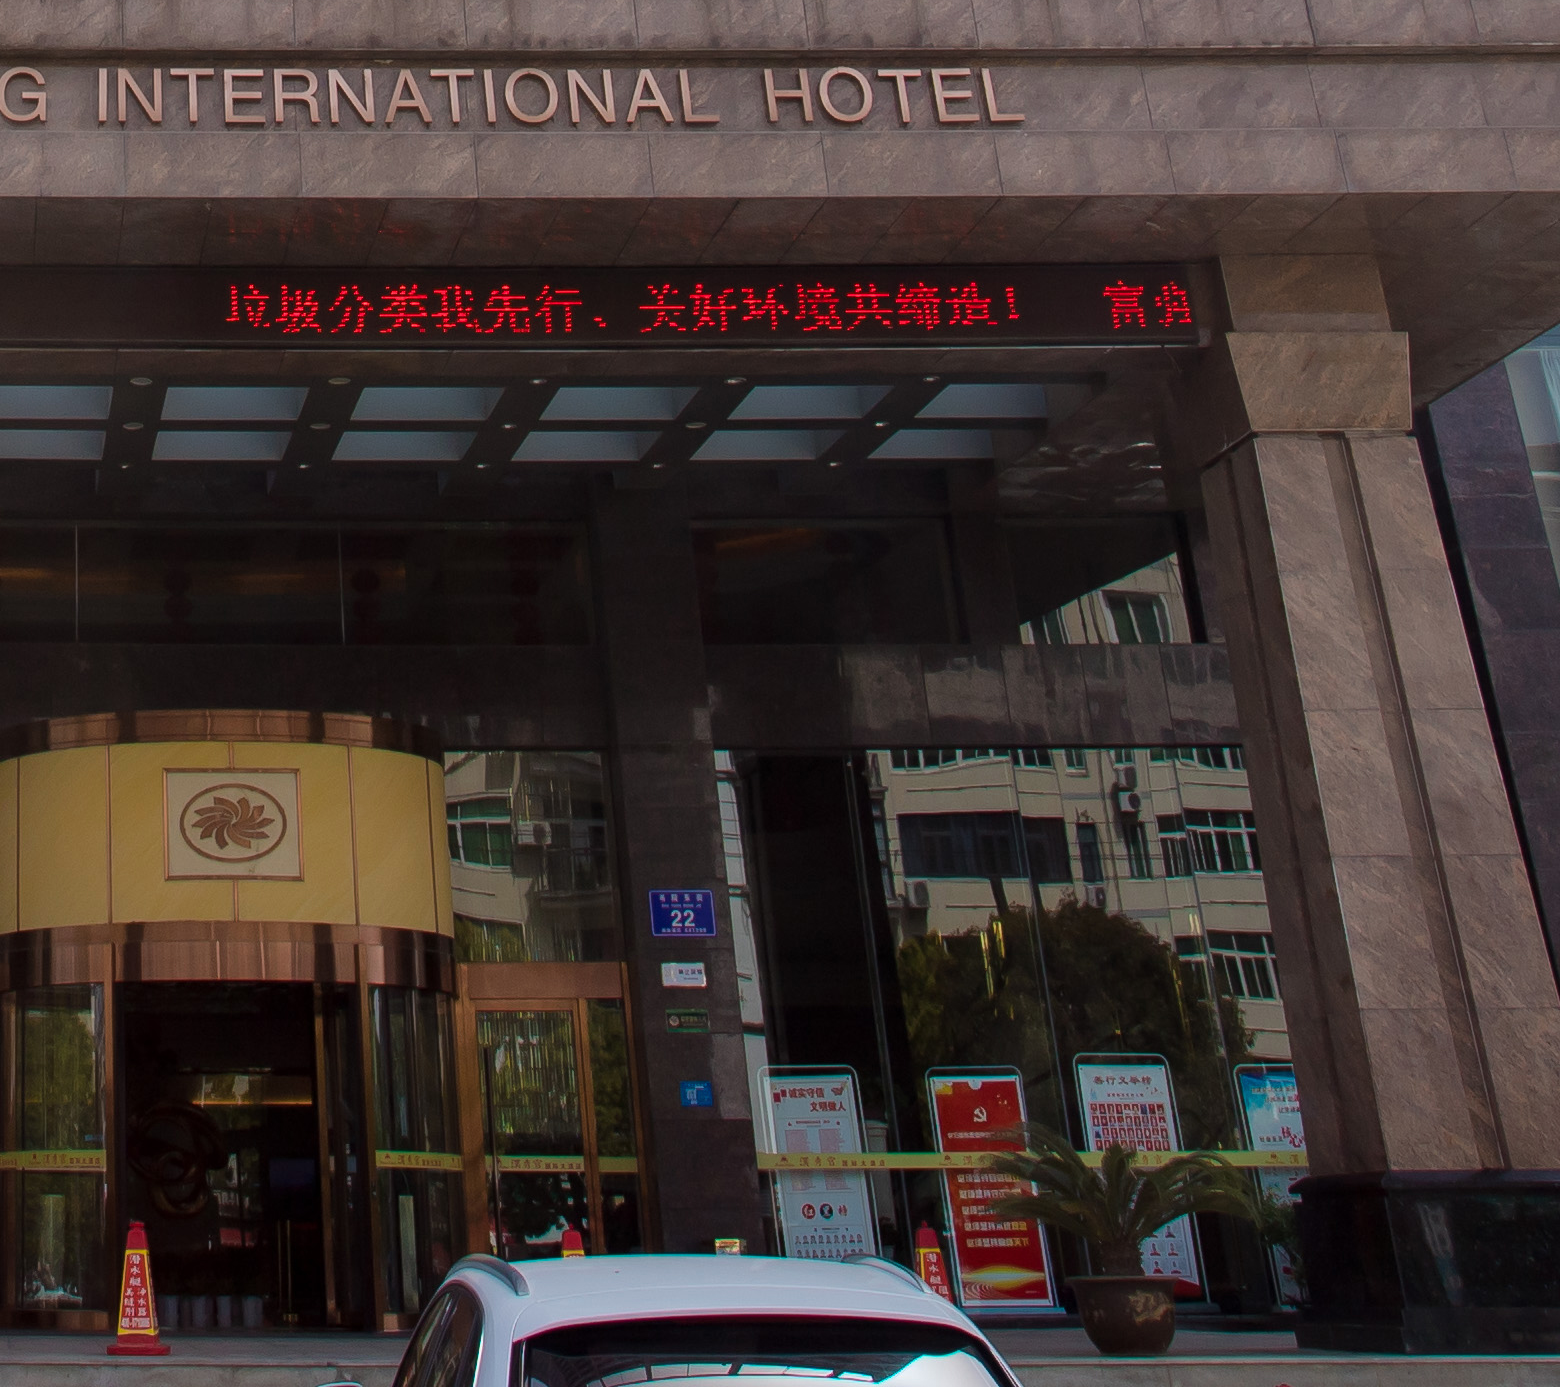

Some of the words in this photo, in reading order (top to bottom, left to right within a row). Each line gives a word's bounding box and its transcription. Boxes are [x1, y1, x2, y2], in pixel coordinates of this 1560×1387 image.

[97, 65, 720, 126] INTERNATIONAL
[764, 67, 1027, 126] HOTEL
[670, 909, 695, 927] 22
